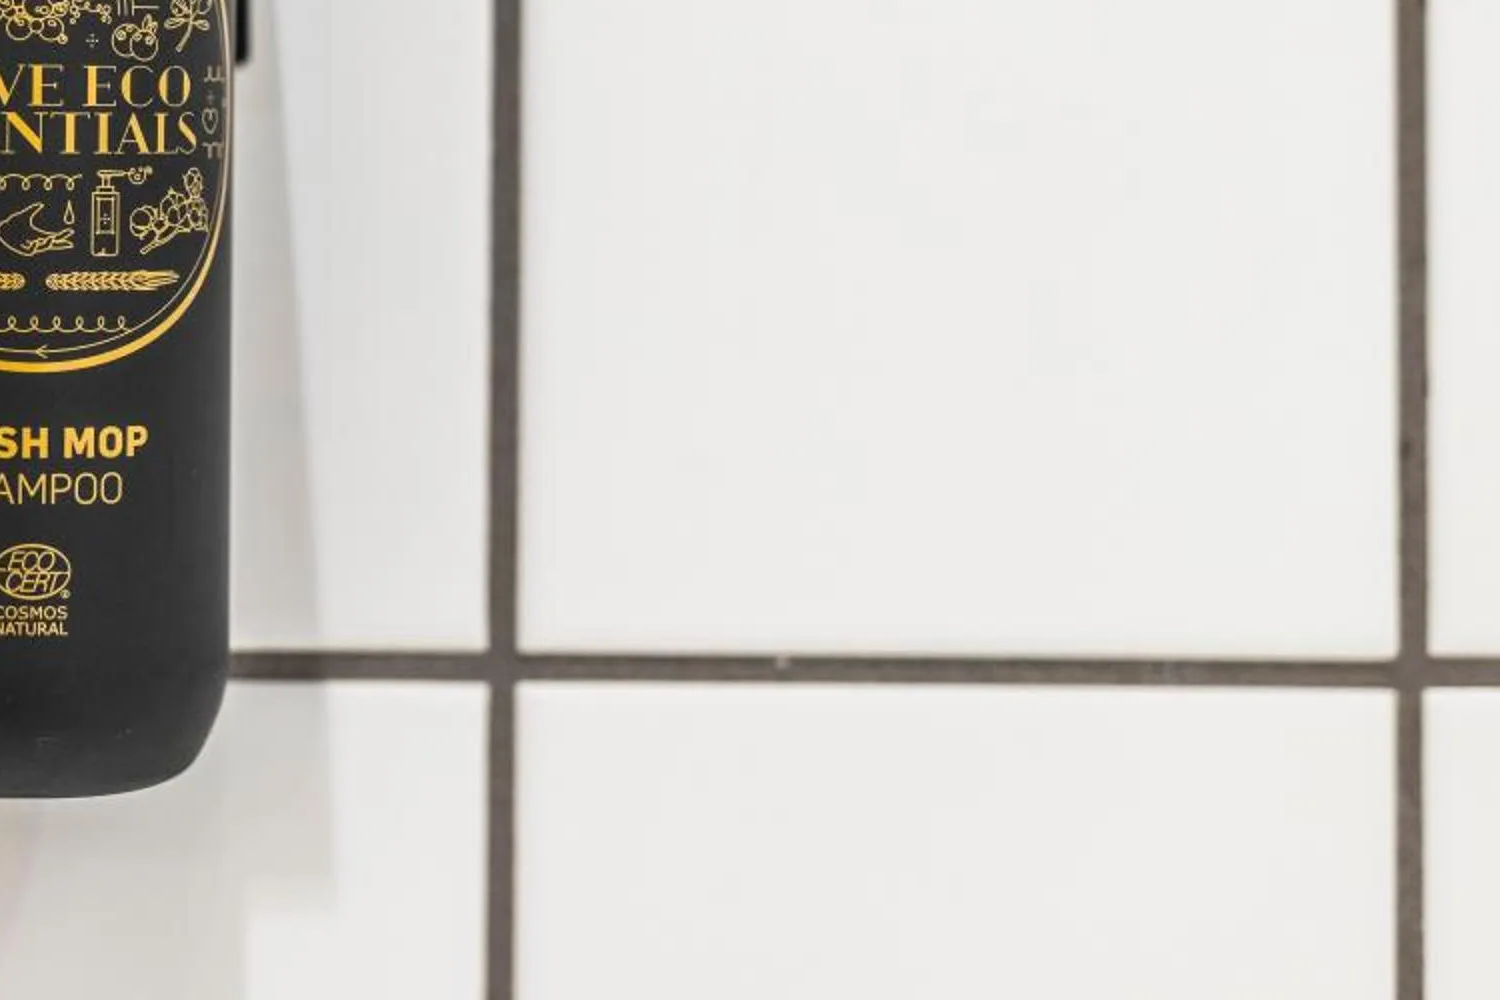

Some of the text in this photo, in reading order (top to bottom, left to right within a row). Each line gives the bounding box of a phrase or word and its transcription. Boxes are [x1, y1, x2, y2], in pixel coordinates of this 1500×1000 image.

[82, 65, 191, 108] ECO
[63, 425, 149, 459] MOP
[8, 551, 55, 571] ECO
[5, 571, 60, 593] CERT
